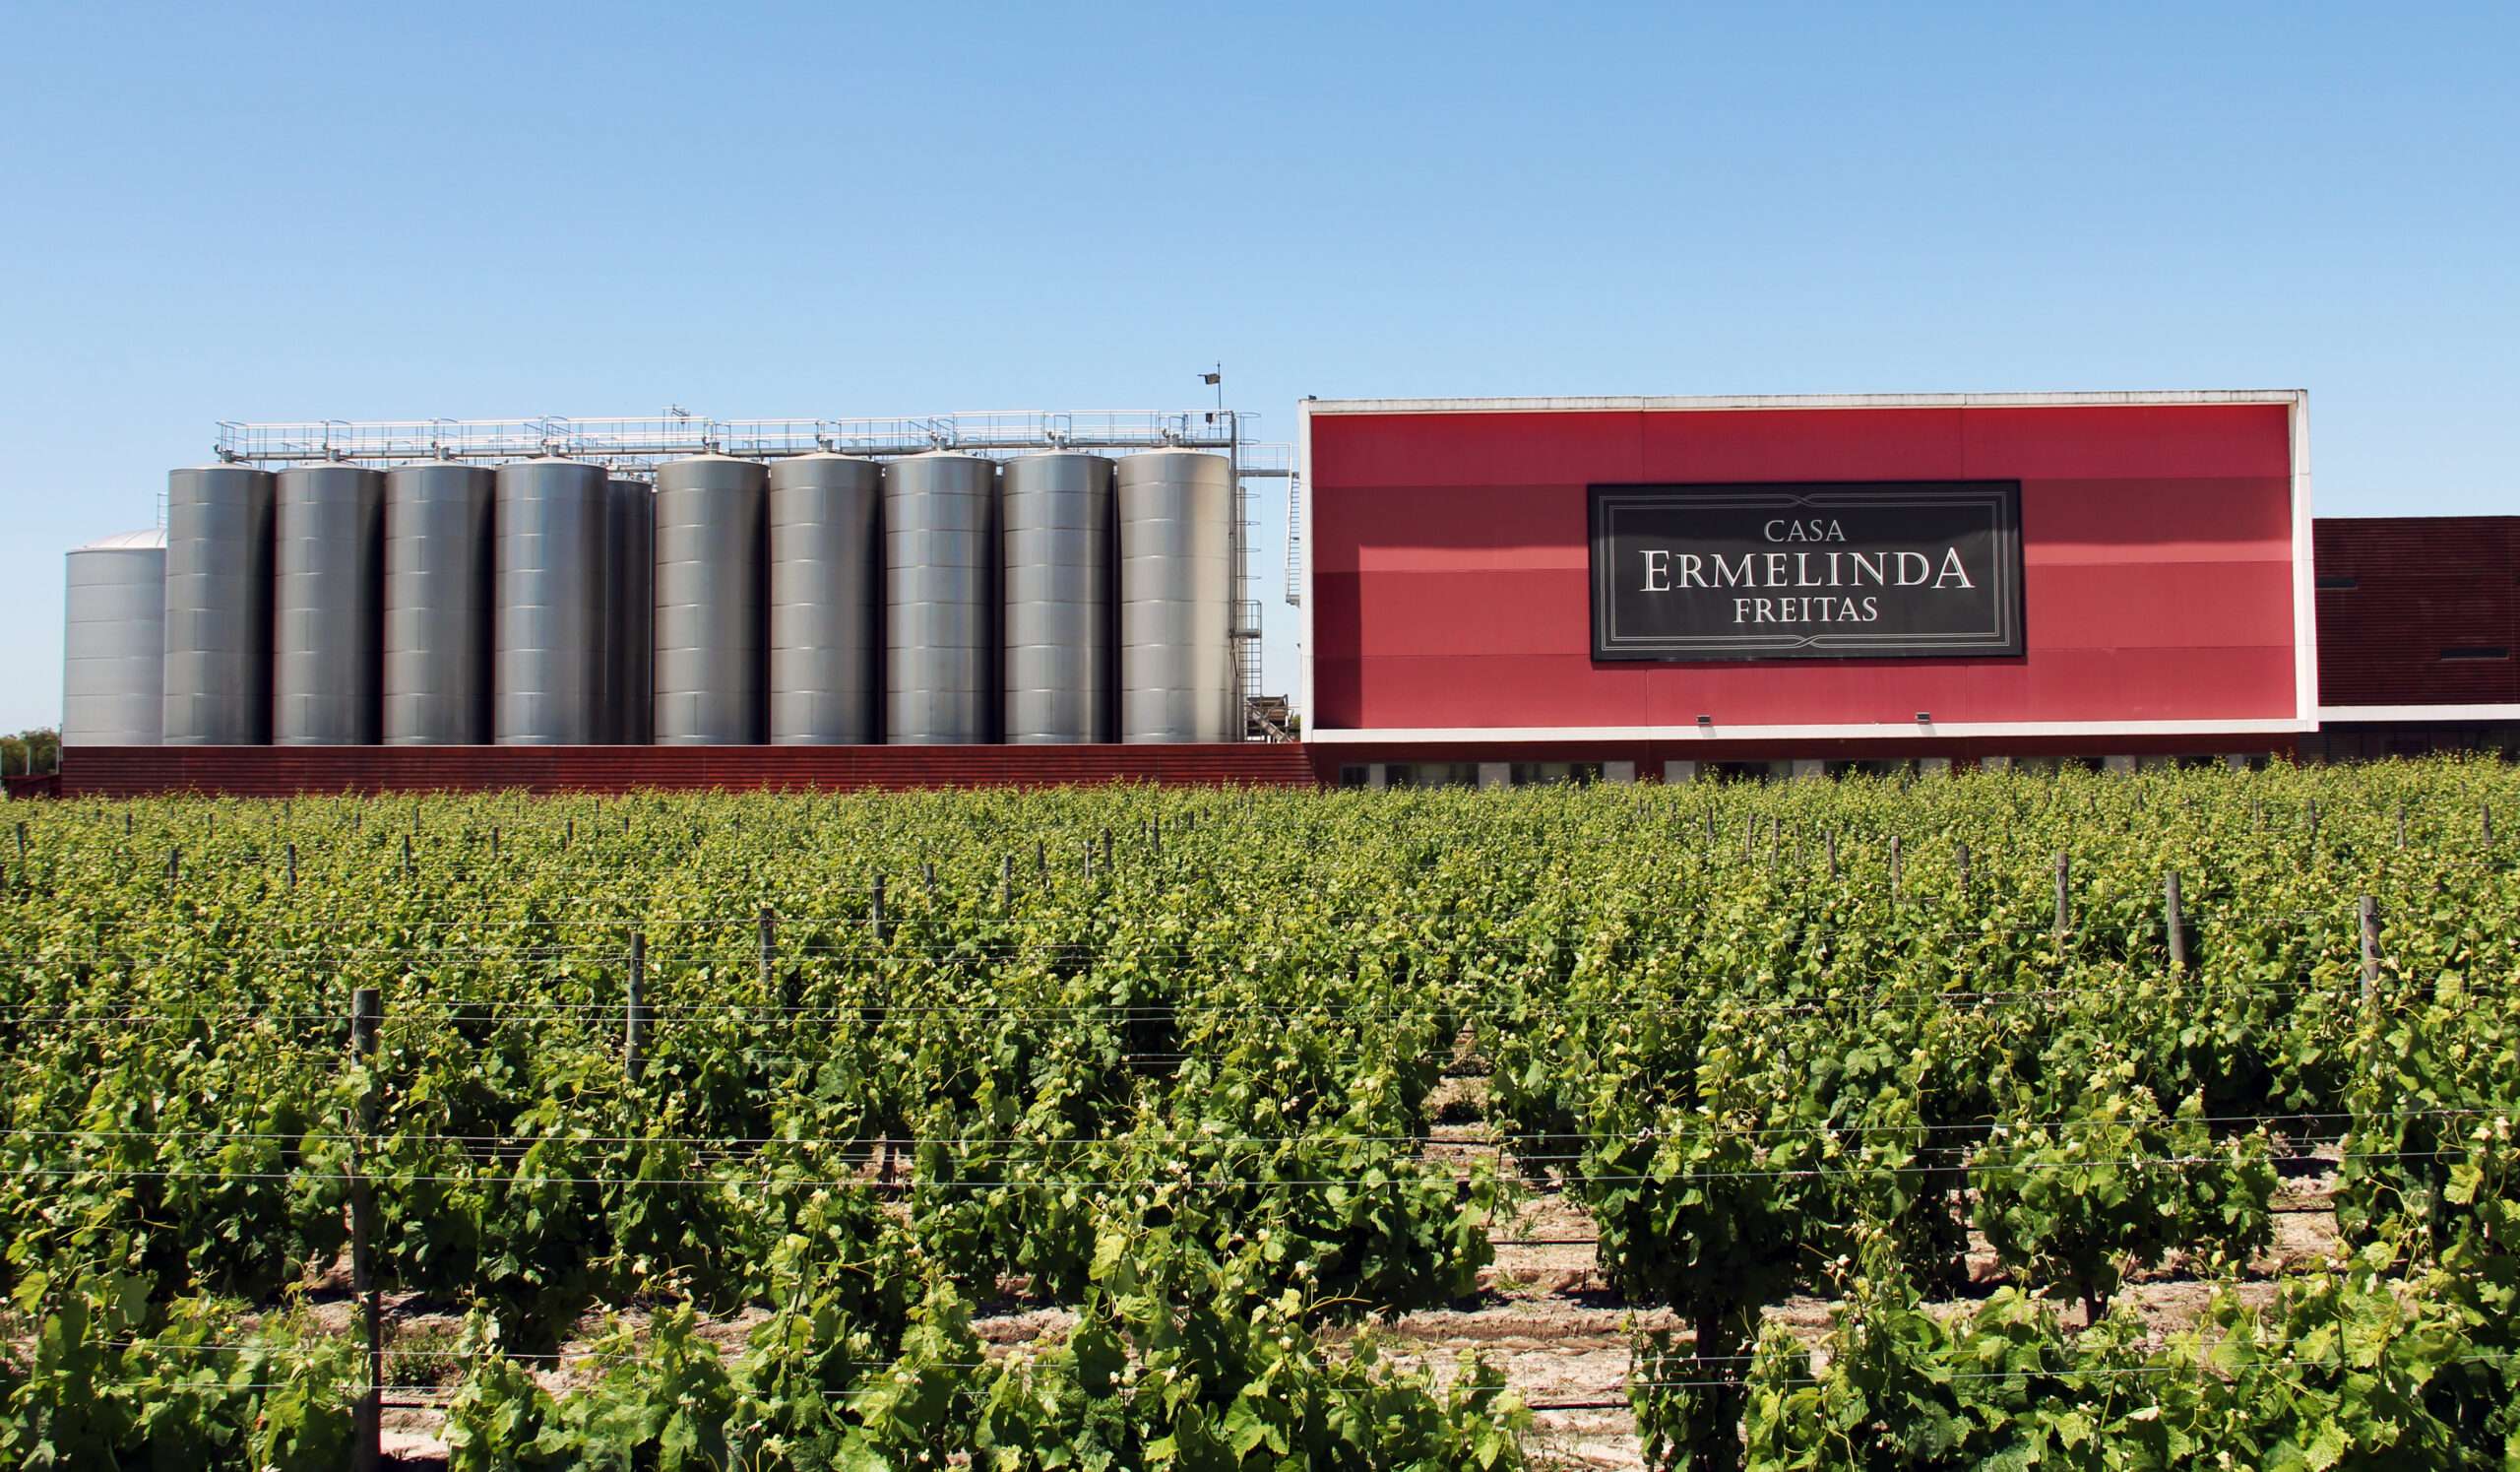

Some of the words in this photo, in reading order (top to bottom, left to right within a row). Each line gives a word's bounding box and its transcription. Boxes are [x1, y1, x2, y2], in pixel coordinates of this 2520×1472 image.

[1763, 519, 1847, 543] CASA
[1639, 546, 1976, 592] ERMELINDA
[1732, 596, 1878, 623] FREITAS
